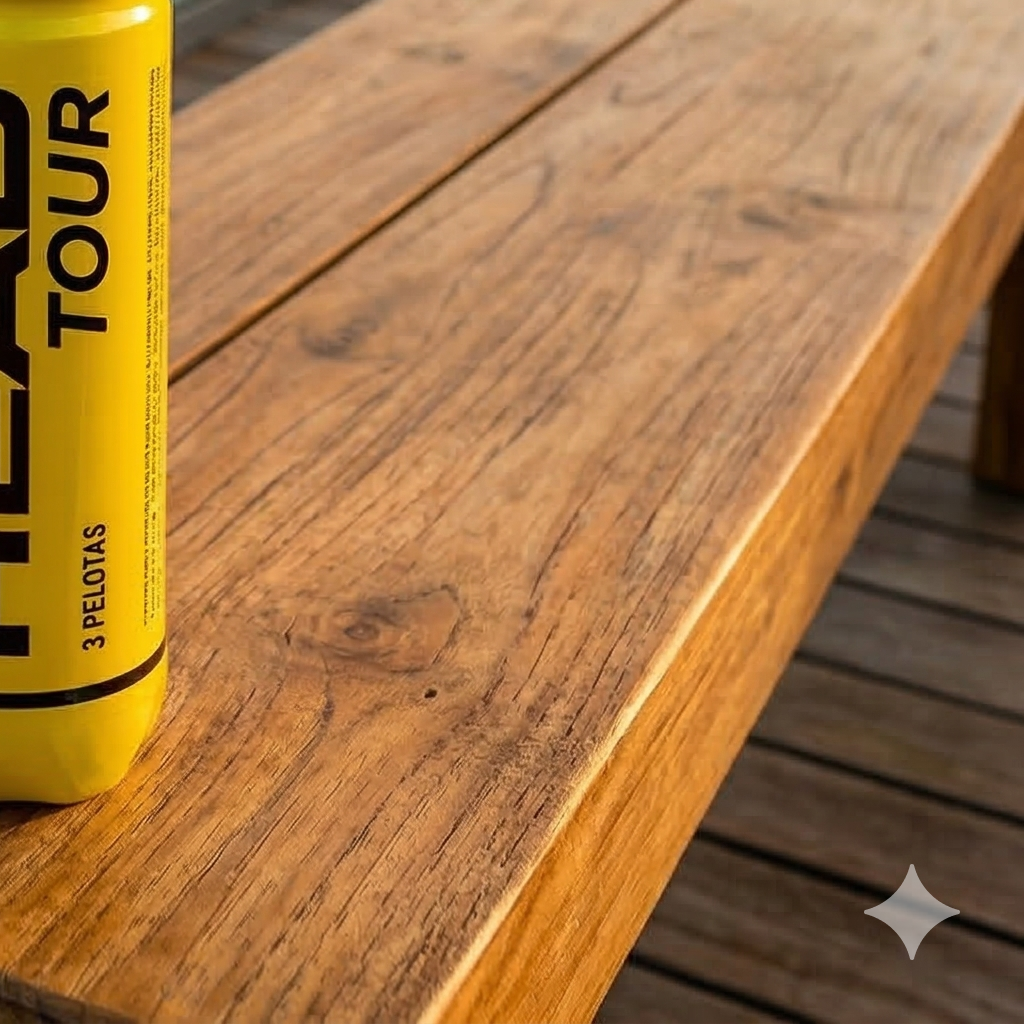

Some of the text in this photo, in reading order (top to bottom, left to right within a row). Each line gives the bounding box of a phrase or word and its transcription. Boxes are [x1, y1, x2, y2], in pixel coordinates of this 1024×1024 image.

[47, 87, 109, 348] TOUR
[82, 524, 106, 651] 3 PELOTAS
